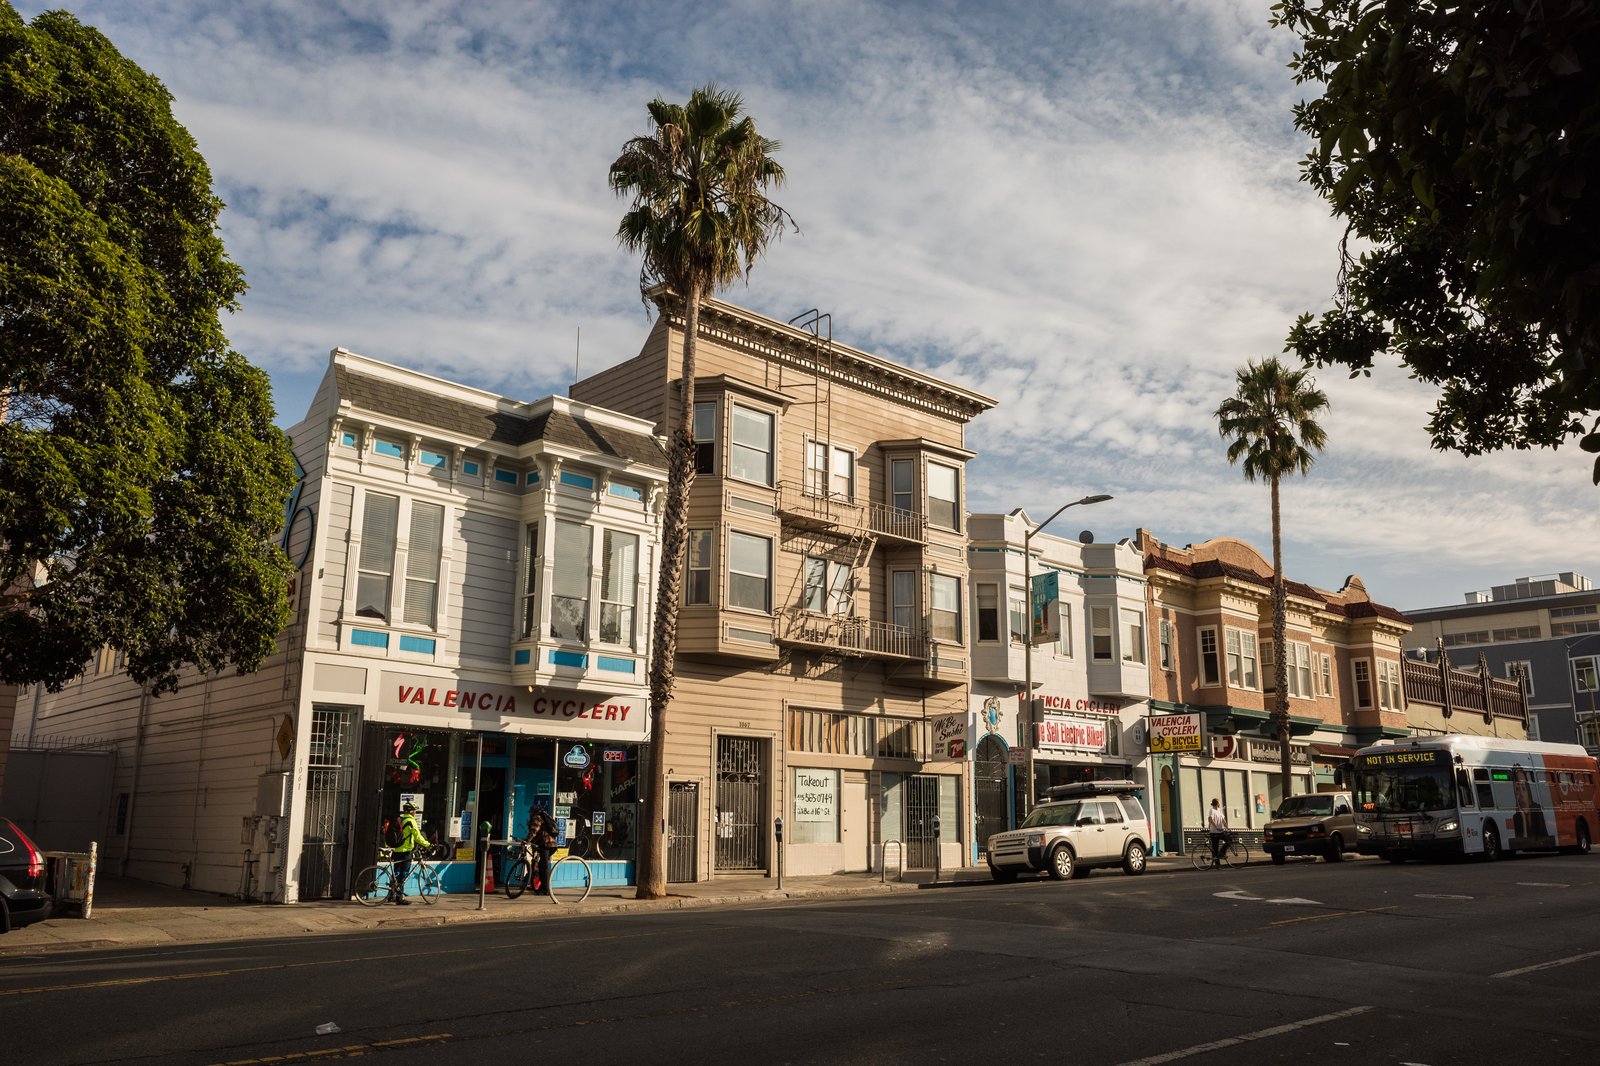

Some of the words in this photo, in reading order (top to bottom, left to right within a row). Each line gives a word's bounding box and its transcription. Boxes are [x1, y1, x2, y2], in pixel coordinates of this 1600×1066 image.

[398, 685, 516, 713] VALENCIA
[533, 697, 631, 721] CYCLERY
[1076, 699, 1121, 715] CYCLERY
[1151, 716, 1191, 727] VALENCIA
[1046, 721, 1060, 743] Sell
[1061, 723, 1085, 746] Electric
[1086, 725, 1105, 747] Bikes!
[1162, 725, 1198, 736] CYCLERY
[1172, 736, 1199, 746] BICYCLE
[604, 751, 626, 761] OPEN
[1366, 756, 1382, 765] NOT
[1385, 755, 1395, 764] IN
[1397, 752, 1435, 763] SERVICE
[798, 775, 830, 787] Takeout
